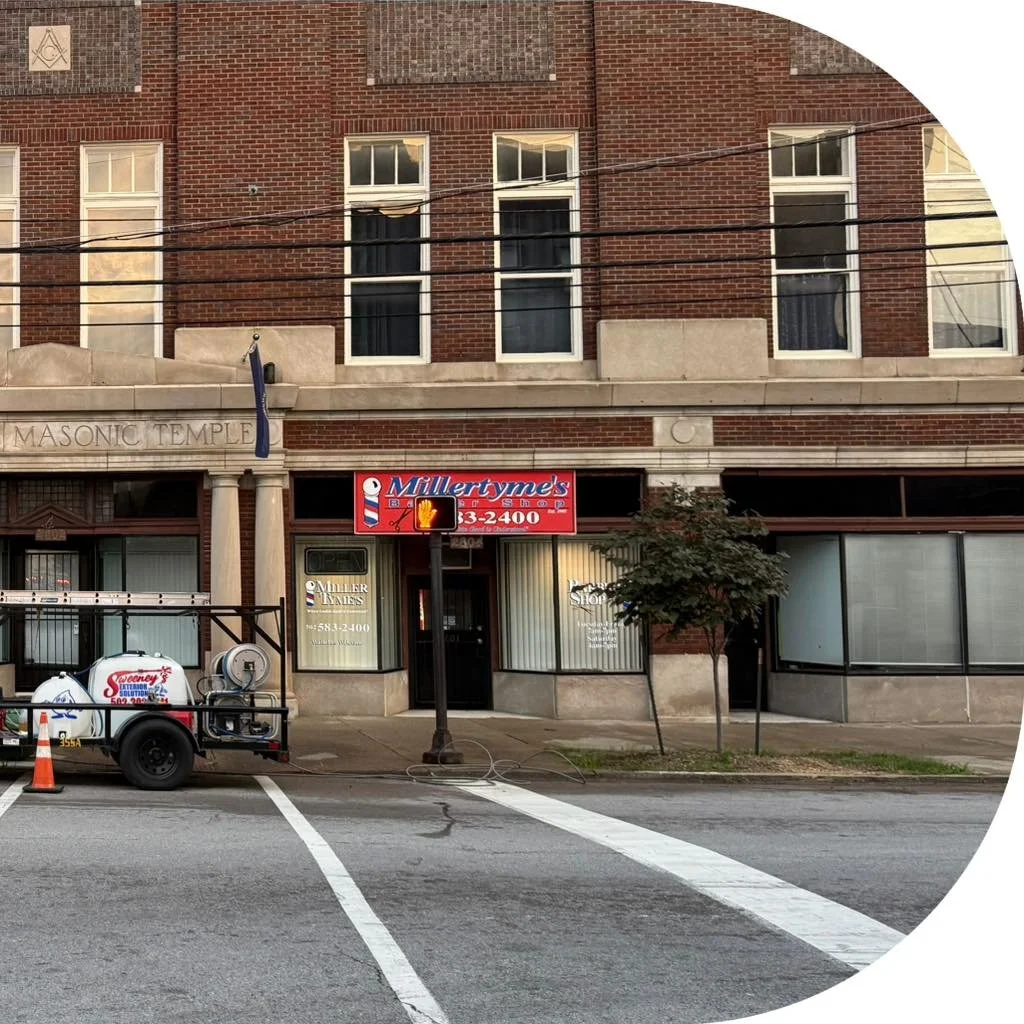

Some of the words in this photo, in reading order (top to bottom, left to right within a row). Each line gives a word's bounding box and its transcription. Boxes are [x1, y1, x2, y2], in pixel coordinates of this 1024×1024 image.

[12, 422, 141, 449] MASONIC
[153, 421, 255, 446] TEMPLE
[384, 474, 570, 502] Millertyme's
[316, 580, 369, 593] MILLER
[103, 671, 169, 698] Sweeney's
[119, 683, 148, 691] EXTERIOR
